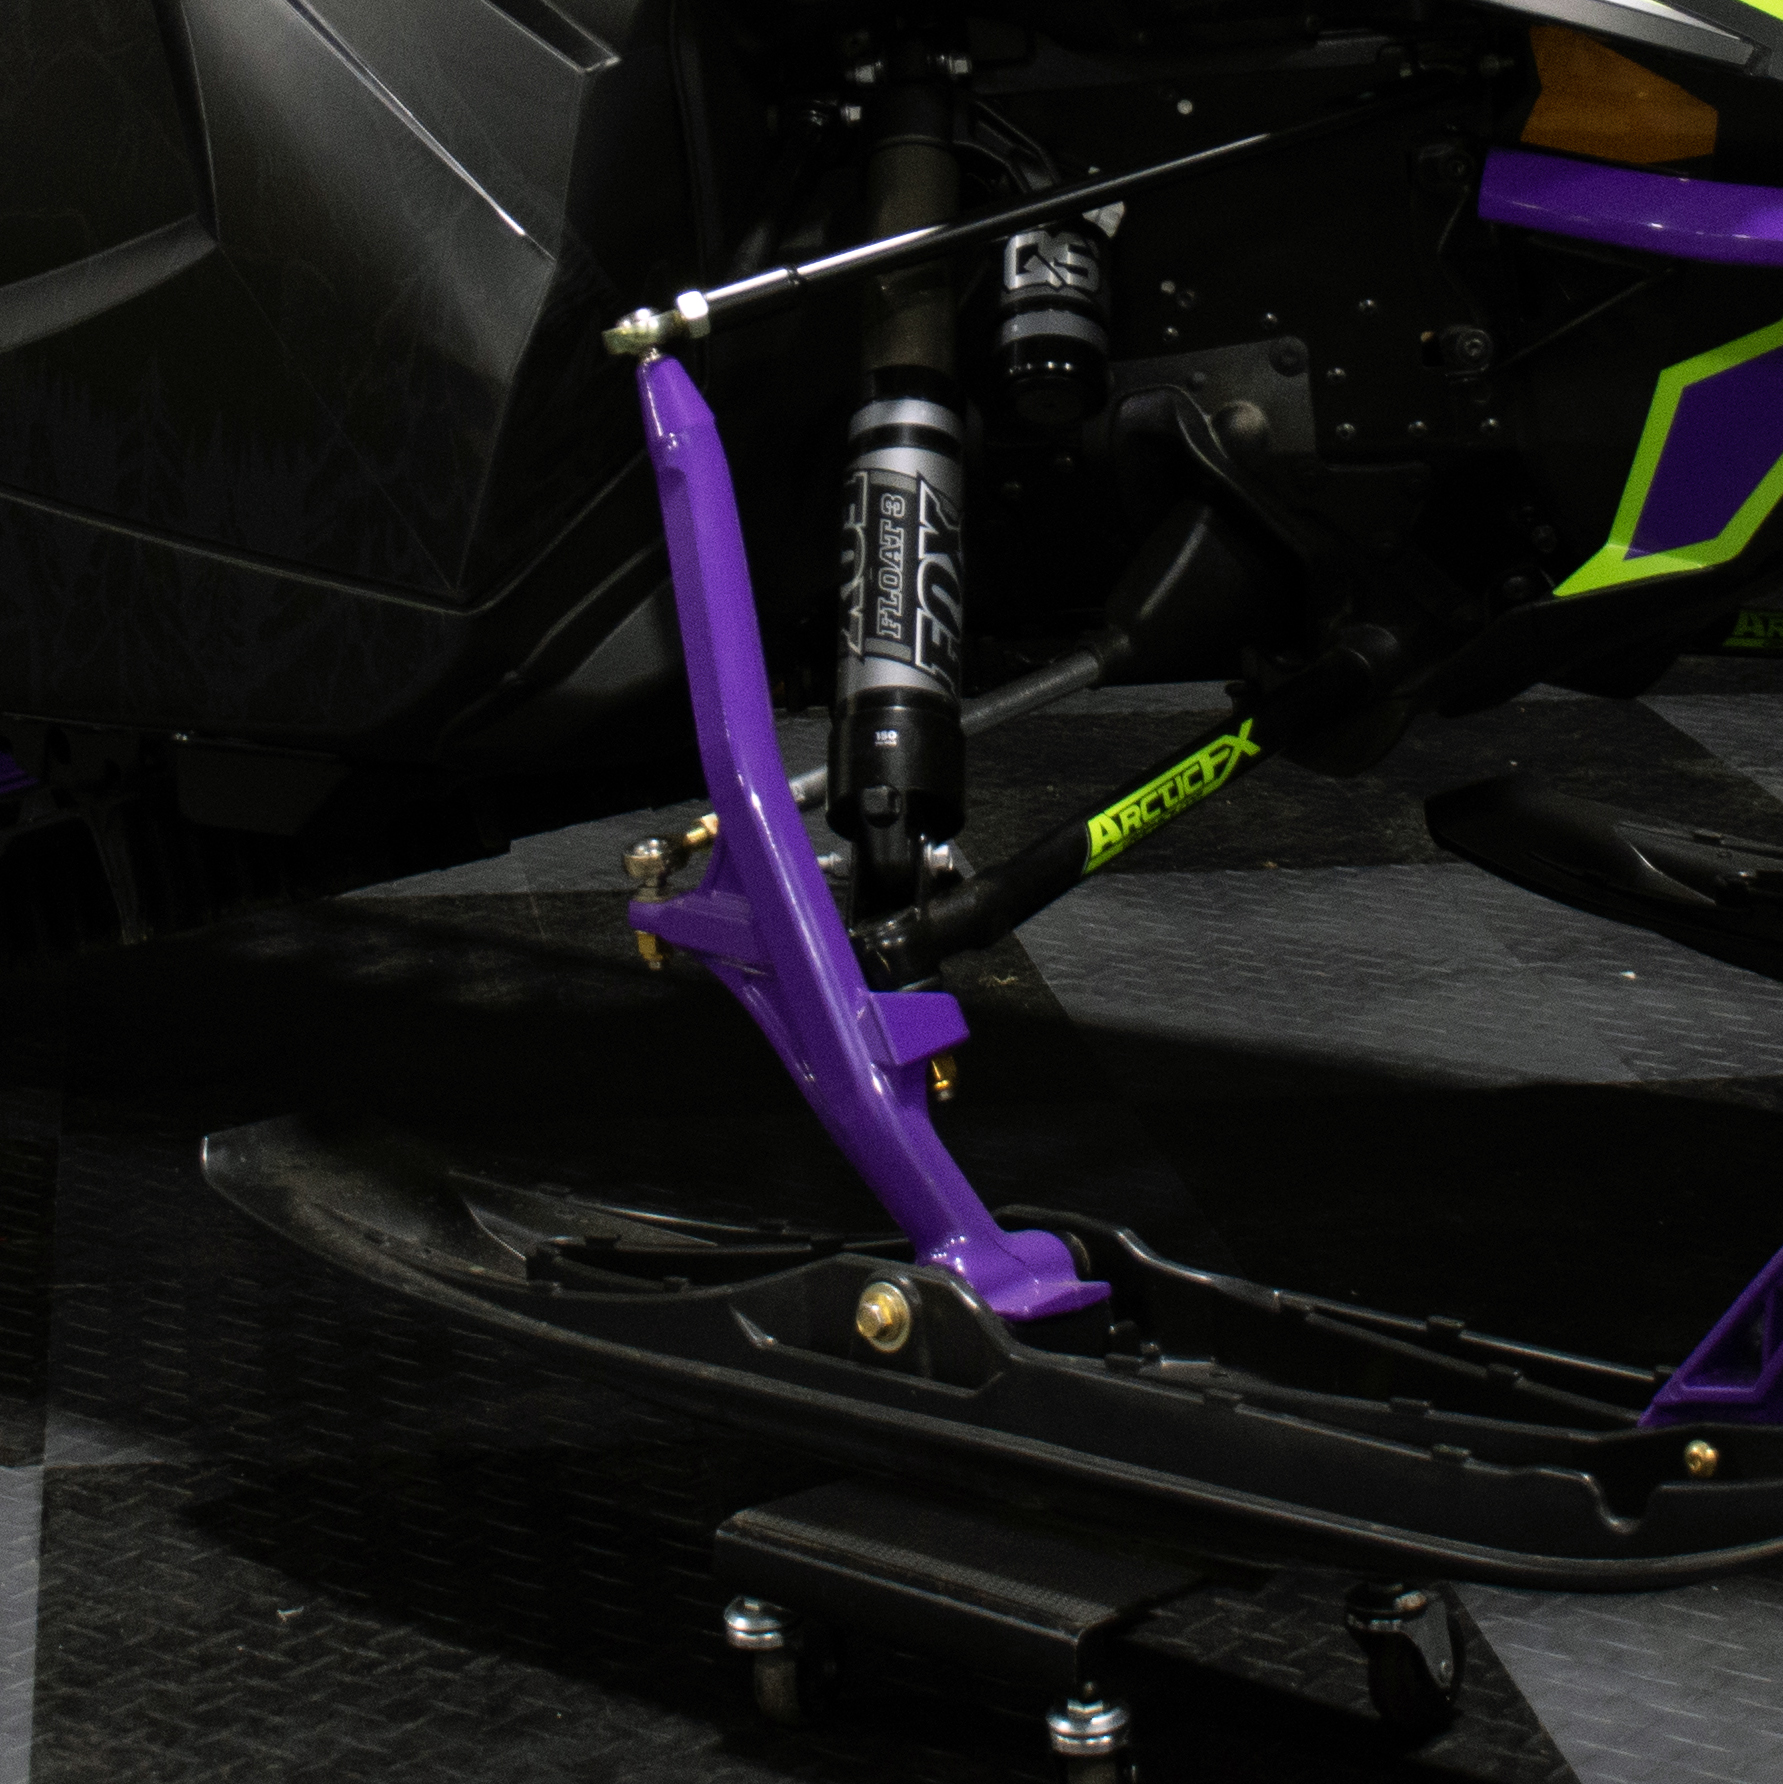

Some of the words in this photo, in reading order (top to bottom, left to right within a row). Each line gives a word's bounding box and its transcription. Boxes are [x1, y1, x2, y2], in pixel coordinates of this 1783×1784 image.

[880, 492, 906, 517] 3
[876, 518, 905, 641] FLOAT
[1082, 717, 1262, 875] ARCTICFX
